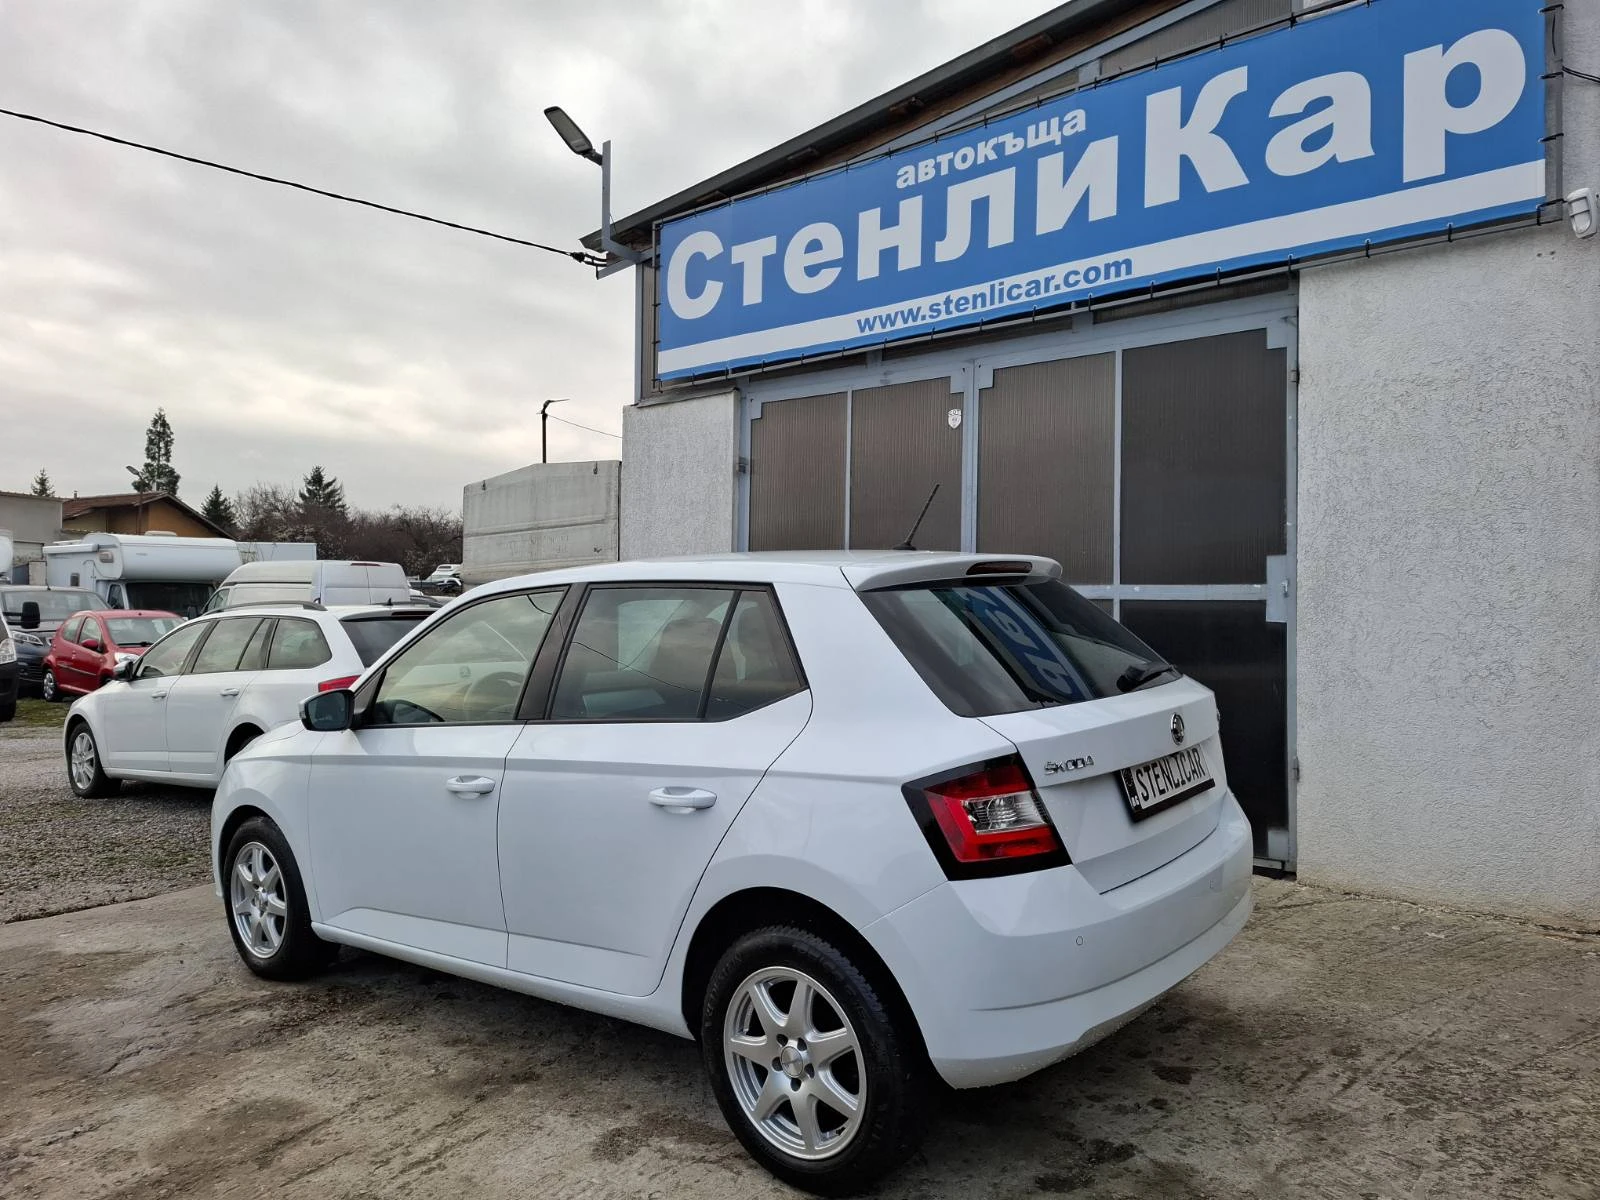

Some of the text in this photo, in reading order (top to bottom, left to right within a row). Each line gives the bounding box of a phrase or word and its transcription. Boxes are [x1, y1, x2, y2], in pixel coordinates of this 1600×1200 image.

[667, 29, 1526, 319] СтенлиКар
[896, 108, 1086, 188] автокъща
[857, 257, 1132, 333] www.stenlicar.com
[1137, 748, 1204, 801] STENLICAR
